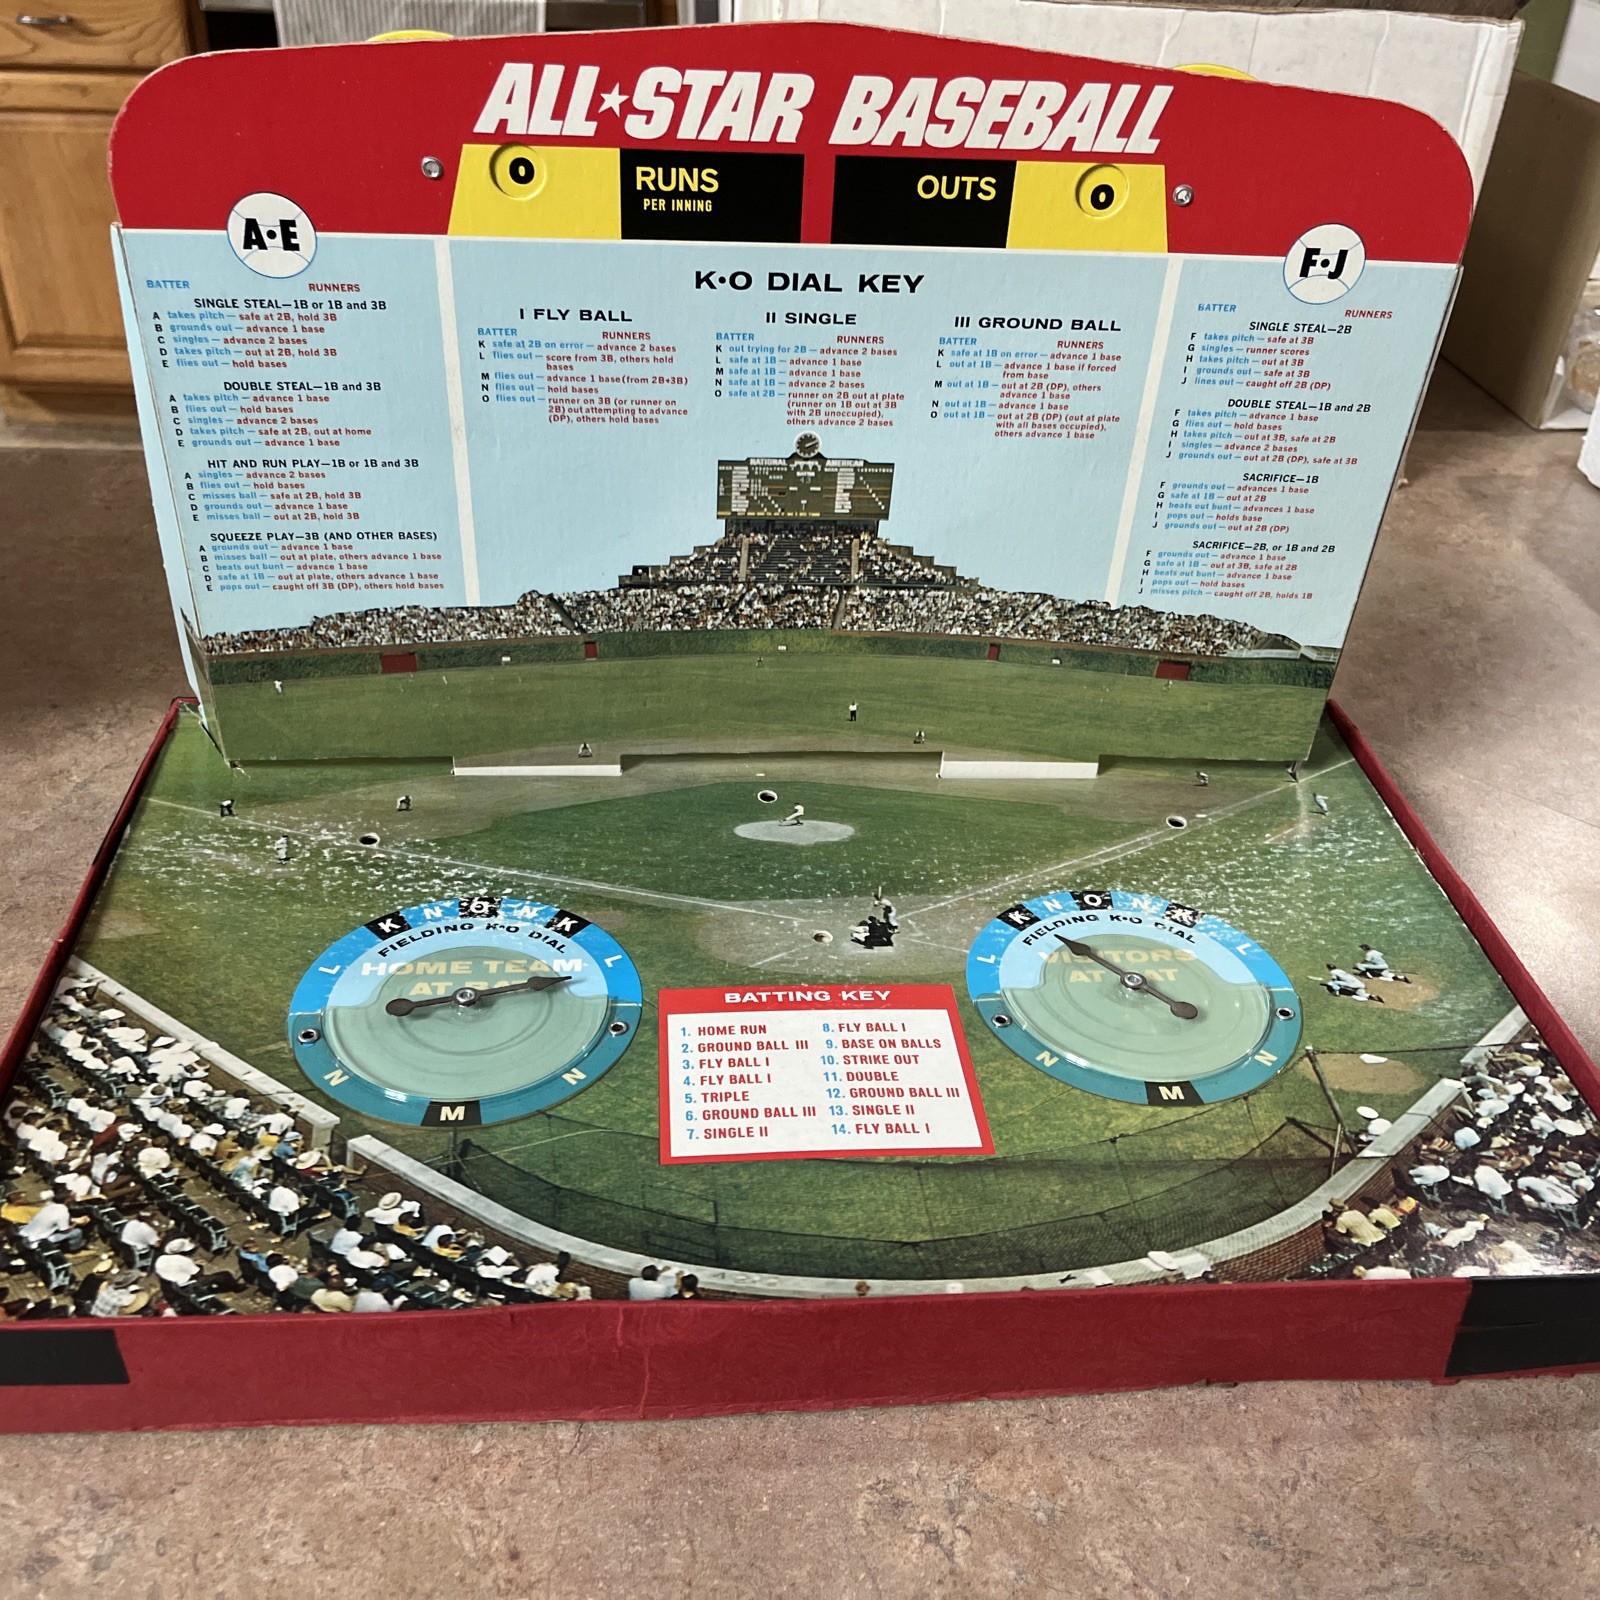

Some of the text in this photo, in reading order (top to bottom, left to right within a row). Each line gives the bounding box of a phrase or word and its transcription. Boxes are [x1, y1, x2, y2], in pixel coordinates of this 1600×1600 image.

[828, 75, 1174, 154] BASEBALL
[636, 166, 718, 192] RUNS
[917, 175, 996, 200] OUTS
[644, 198, 712, 212] PER INNING
[147, 280, 189, 289] BATTER
[768, 272, 842, 292] DIAL
[859, 274, 924, 293] KEY
[194, 299, 239, 309] SINGLE
[328, 300, 343, 309] 1B
[347, 301, 367, 310] and
[371, 301, 386, 310] 3B
[1198, 304, 1236, 313] BATTER
[534, 309, 570, 320] FLY
[579, 310, 632, 322] BALL
[785, 313, 856, 325] SINGLE
[1345, 310, 1392, 319] RUNNERS
[979, 317, 1063, 330] GROUND
[1071, 319, 1121, 331] BALL
[1250, 321, 1289, 332] SINGLE
[837, 336, 884, 344] RUNNERS
[1204, 334, 1228, 342] takes
[1231, 334, 1254, 344] pitch
[1057, 341, 1104, 349] RUNNERS
[176, 359, 198, 368] flies
[224, 382, 272, 391] DOUBLE
[342, 382, 362, 391] and
[366, 382, 381, 390] 3B
[1228, 399, 1271, 408] DOUBLE
[1335, 403, 1352, 412] and
[1356, 403, 1371, 412] 2B
[208, 460, 227, 468] HIT
[233, 460, 257, 468] AND
[262, 460, 286, 468] RUN
[364, 459, 378, 468] 1B
[382, 459, 400, 467] and
[404, 459, 419, 467] 3B
[211, 532, 261, 542] SQUEEZE
[324, 532, 352, 541] (AND
[398, 531, 437, 540] BASES)
[1286, 544, 1298, 552] 1B
[1302, 544, 1318, 552] and
[1322, 544, 1335, 552] 2B
[1023, 914, 1099, 946] FIELDING
[1155, 922, 1196, 944] DIAL
[378, 923, 474, 957] FIELDING
[528, 931, 565, 954] DIAL
[361, 959, 582, 975] HOME TEAM
[1070, 970, 1105, 983] AT
[409, 982, 453, 996] AT
[724, 990, 890, 1003] BATTING KEY
[681, 1025, 766, 1036] 1. HOME RUN
[823, 1023, 834, 1032] 8.
[838, 1022, 860, 1032] FLY
[866, 1022, 898, 1032] BALL
[682, 1043, 693, 1053] 2.
[698, 1041, 751, 1053] GROUND
[757, 1040, 788, 1050] BALL
[826, 1039, 941, 1049] 9. BASE ON BALLS
[683, 1060, 694, 1069] 3.
[700, 1059, 723, 1068] FLY
[728, 1058, 760, 1067] BALL
[820, 1055, 919, 1065] 10. STRIKE OUT
[683, 1076, 695, 1086] 4.
[700, 1076, 724, 1085] FLY
[729, 1074, 762, 1084] BALL
[823, 1071, 899, 1082] 11. DOUBLE
[685, 1091, 749, 1103] 5. TRIPLE
[826, 1088, 845, 1098] 12.
[850, 1087, 904, 1098] GROUND
[909, 1087, 942, 1098] BALL
[686, 1110, 697, 1121] 6.
[703, 1108, 758, 1120] GROUND
[764, 1107, 797, 1118] BALL
[829, 1105, 847, 1116] 13.
[852, 1104, 901, 1115] SINGLE
[687, 1129, 699, 1139] 7.
[704, 1127, 754, 1139] SINGLE
[831, 1124, 850, 1134] 14.
[856, 1124, 881, 1134] FLY
[886, 1123, 919, 1134] BALL
